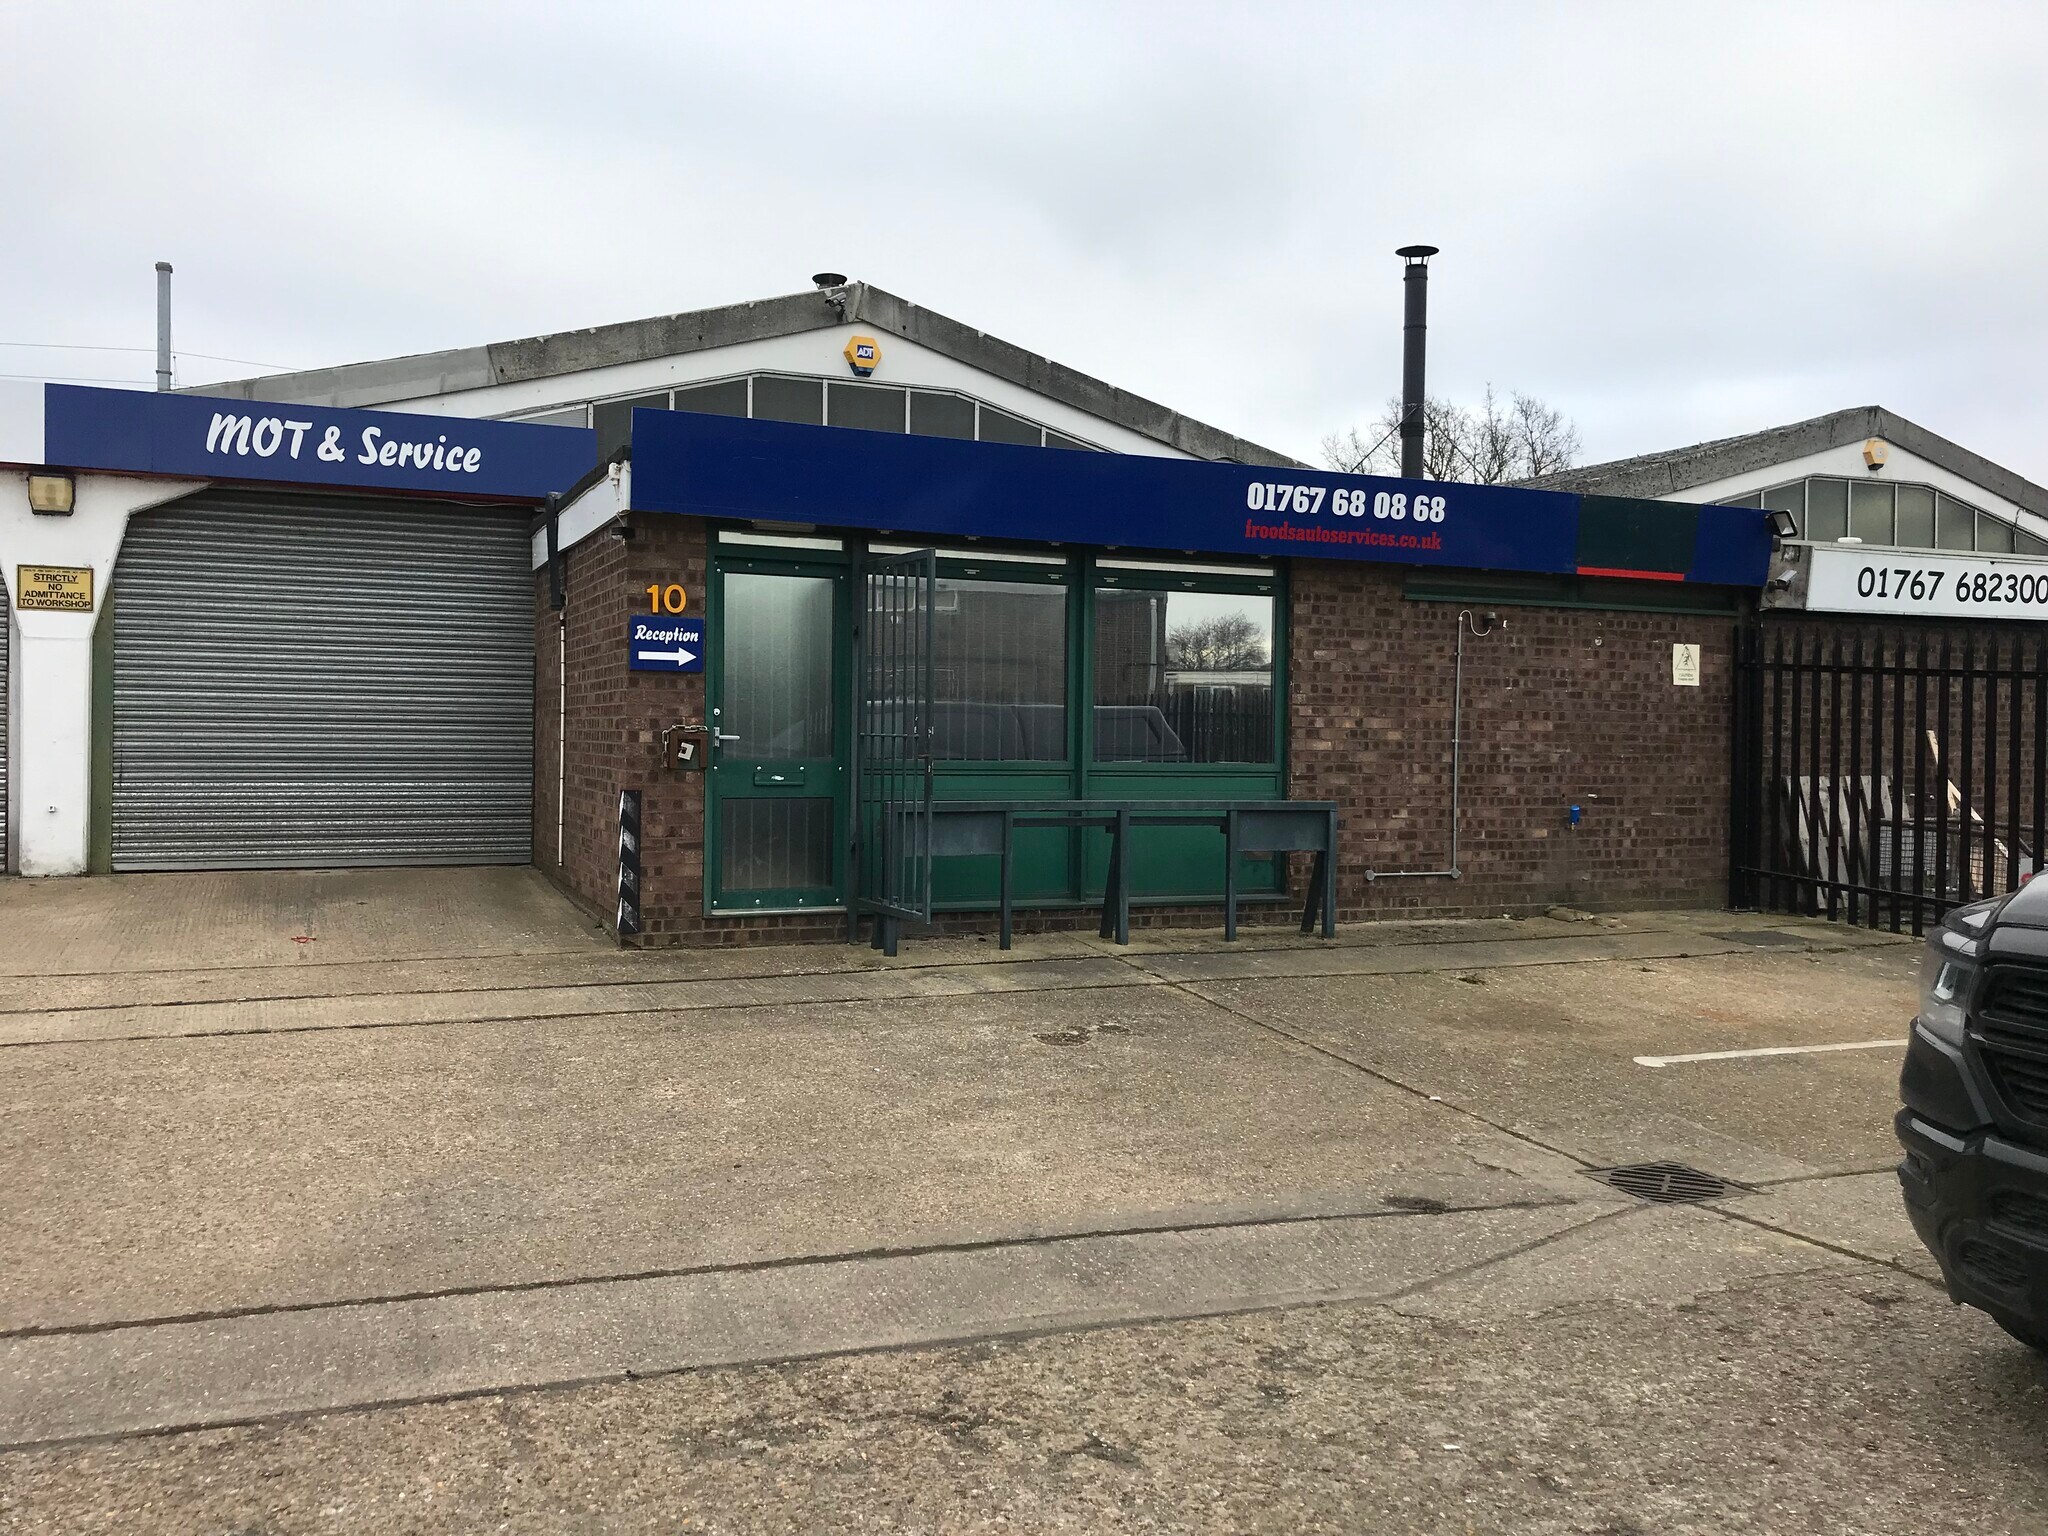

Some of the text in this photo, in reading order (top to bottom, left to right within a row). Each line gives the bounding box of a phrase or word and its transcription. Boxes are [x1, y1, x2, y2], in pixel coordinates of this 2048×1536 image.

[857, 347, 873, 358] ADT
[205, 412, 482, 473] MOT & Service
[1247, 482, 1446, 523] 01767 68 08 68
[1245, 518, 1442, 550] froodsautoservices.co.uk
[33, 573, 78, 582] STRICTLY
[48, 583, 63, 591] NO
[1857, 566, 2048, 604] 01767 682300
[21, 598, 91, 608] TO WORKSHOP
[24, 590, 86, 600] ADMITTANCE
[646, 584, 687, 614] 10
[634, 624, 699, 645] Reception
